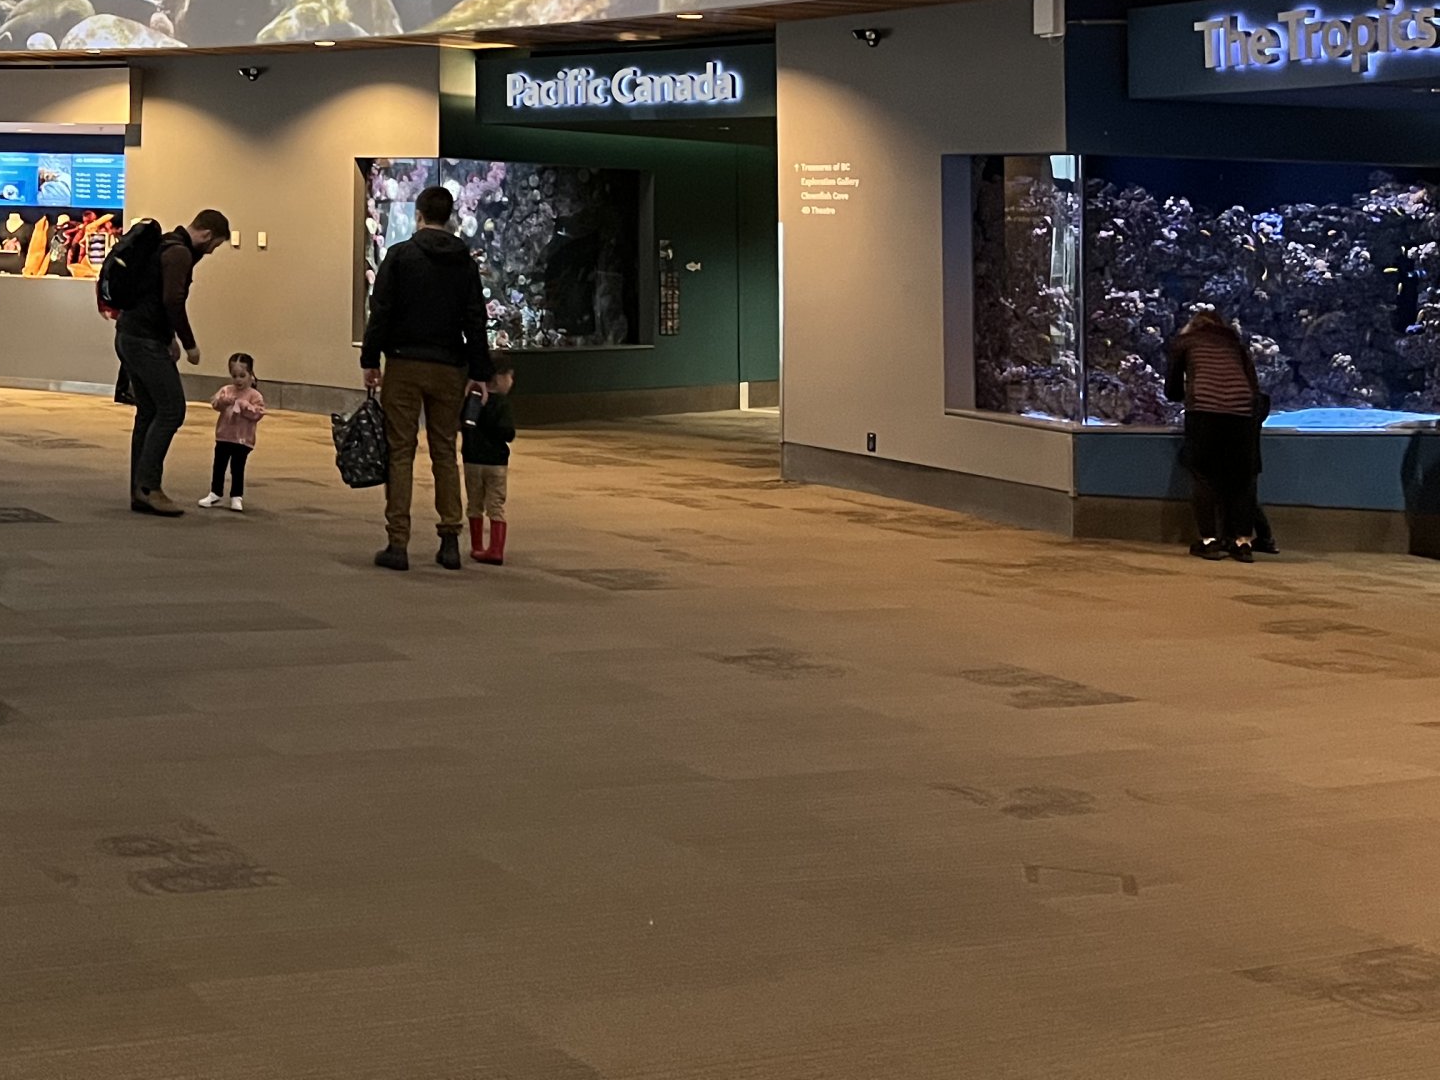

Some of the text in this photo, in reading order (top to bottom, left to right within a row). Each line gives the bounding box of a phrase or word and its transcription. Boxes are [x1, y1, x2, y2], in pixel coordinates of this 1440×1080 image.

[1194, 15, 1280, 69] The
[506, 62, 738, 107] Pacific Canada
[832, 162, 840, 171] of
[840, 162, 851, 171] BC
[836, 177, 860, 188] Gallery
[832, 191, 849, 200] Cove
